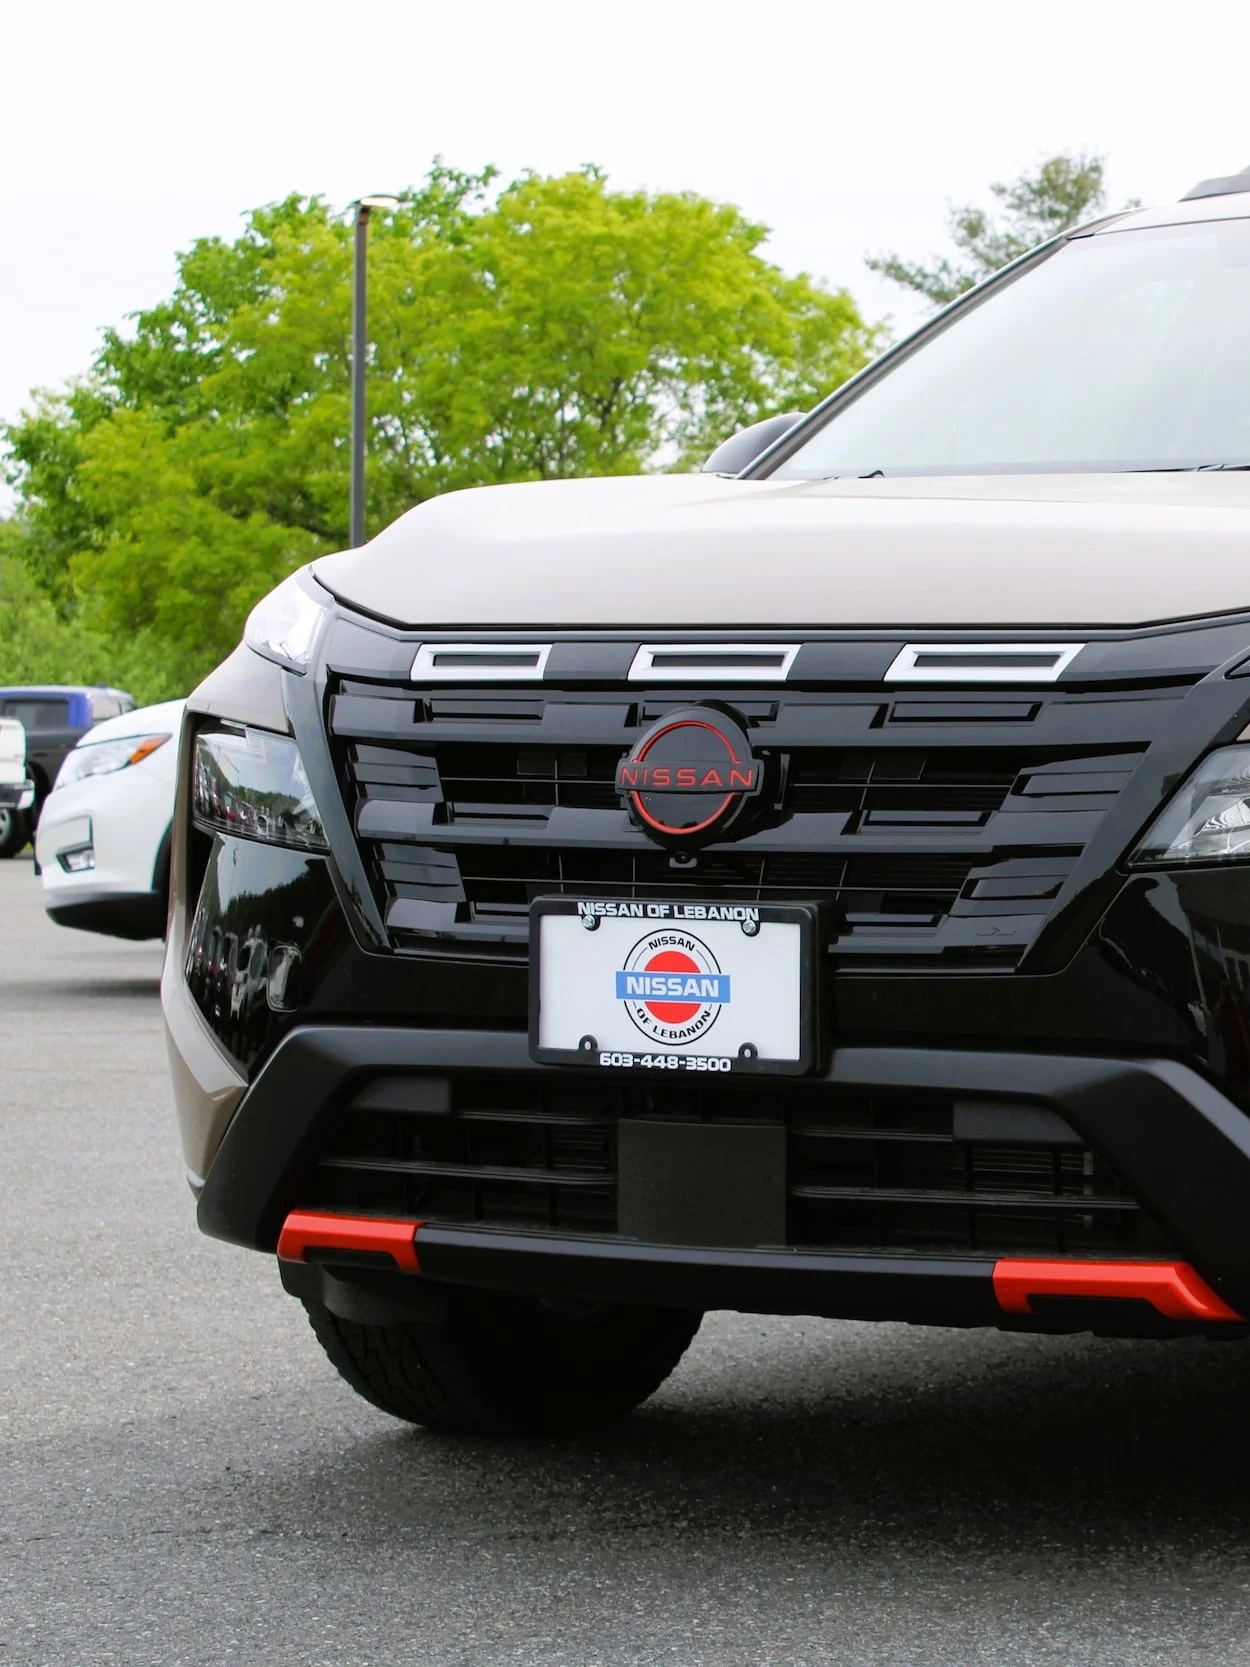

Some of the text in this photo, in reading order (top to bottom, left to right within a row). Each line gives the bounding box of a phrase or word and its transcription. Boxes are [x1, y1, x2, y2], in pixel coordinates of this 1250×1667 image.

[620, 767, 753, 788] NISSAN
[577, 902, 759, 921] NISSAN OF LEBANON
[648, 936, 695, 951] NISSAN
[626, 976, 719, 998] NISSAN
[636, 1008, 711, 1039] OF LEBANON
[599, 1053, 731, 1072] 603-448-3500
